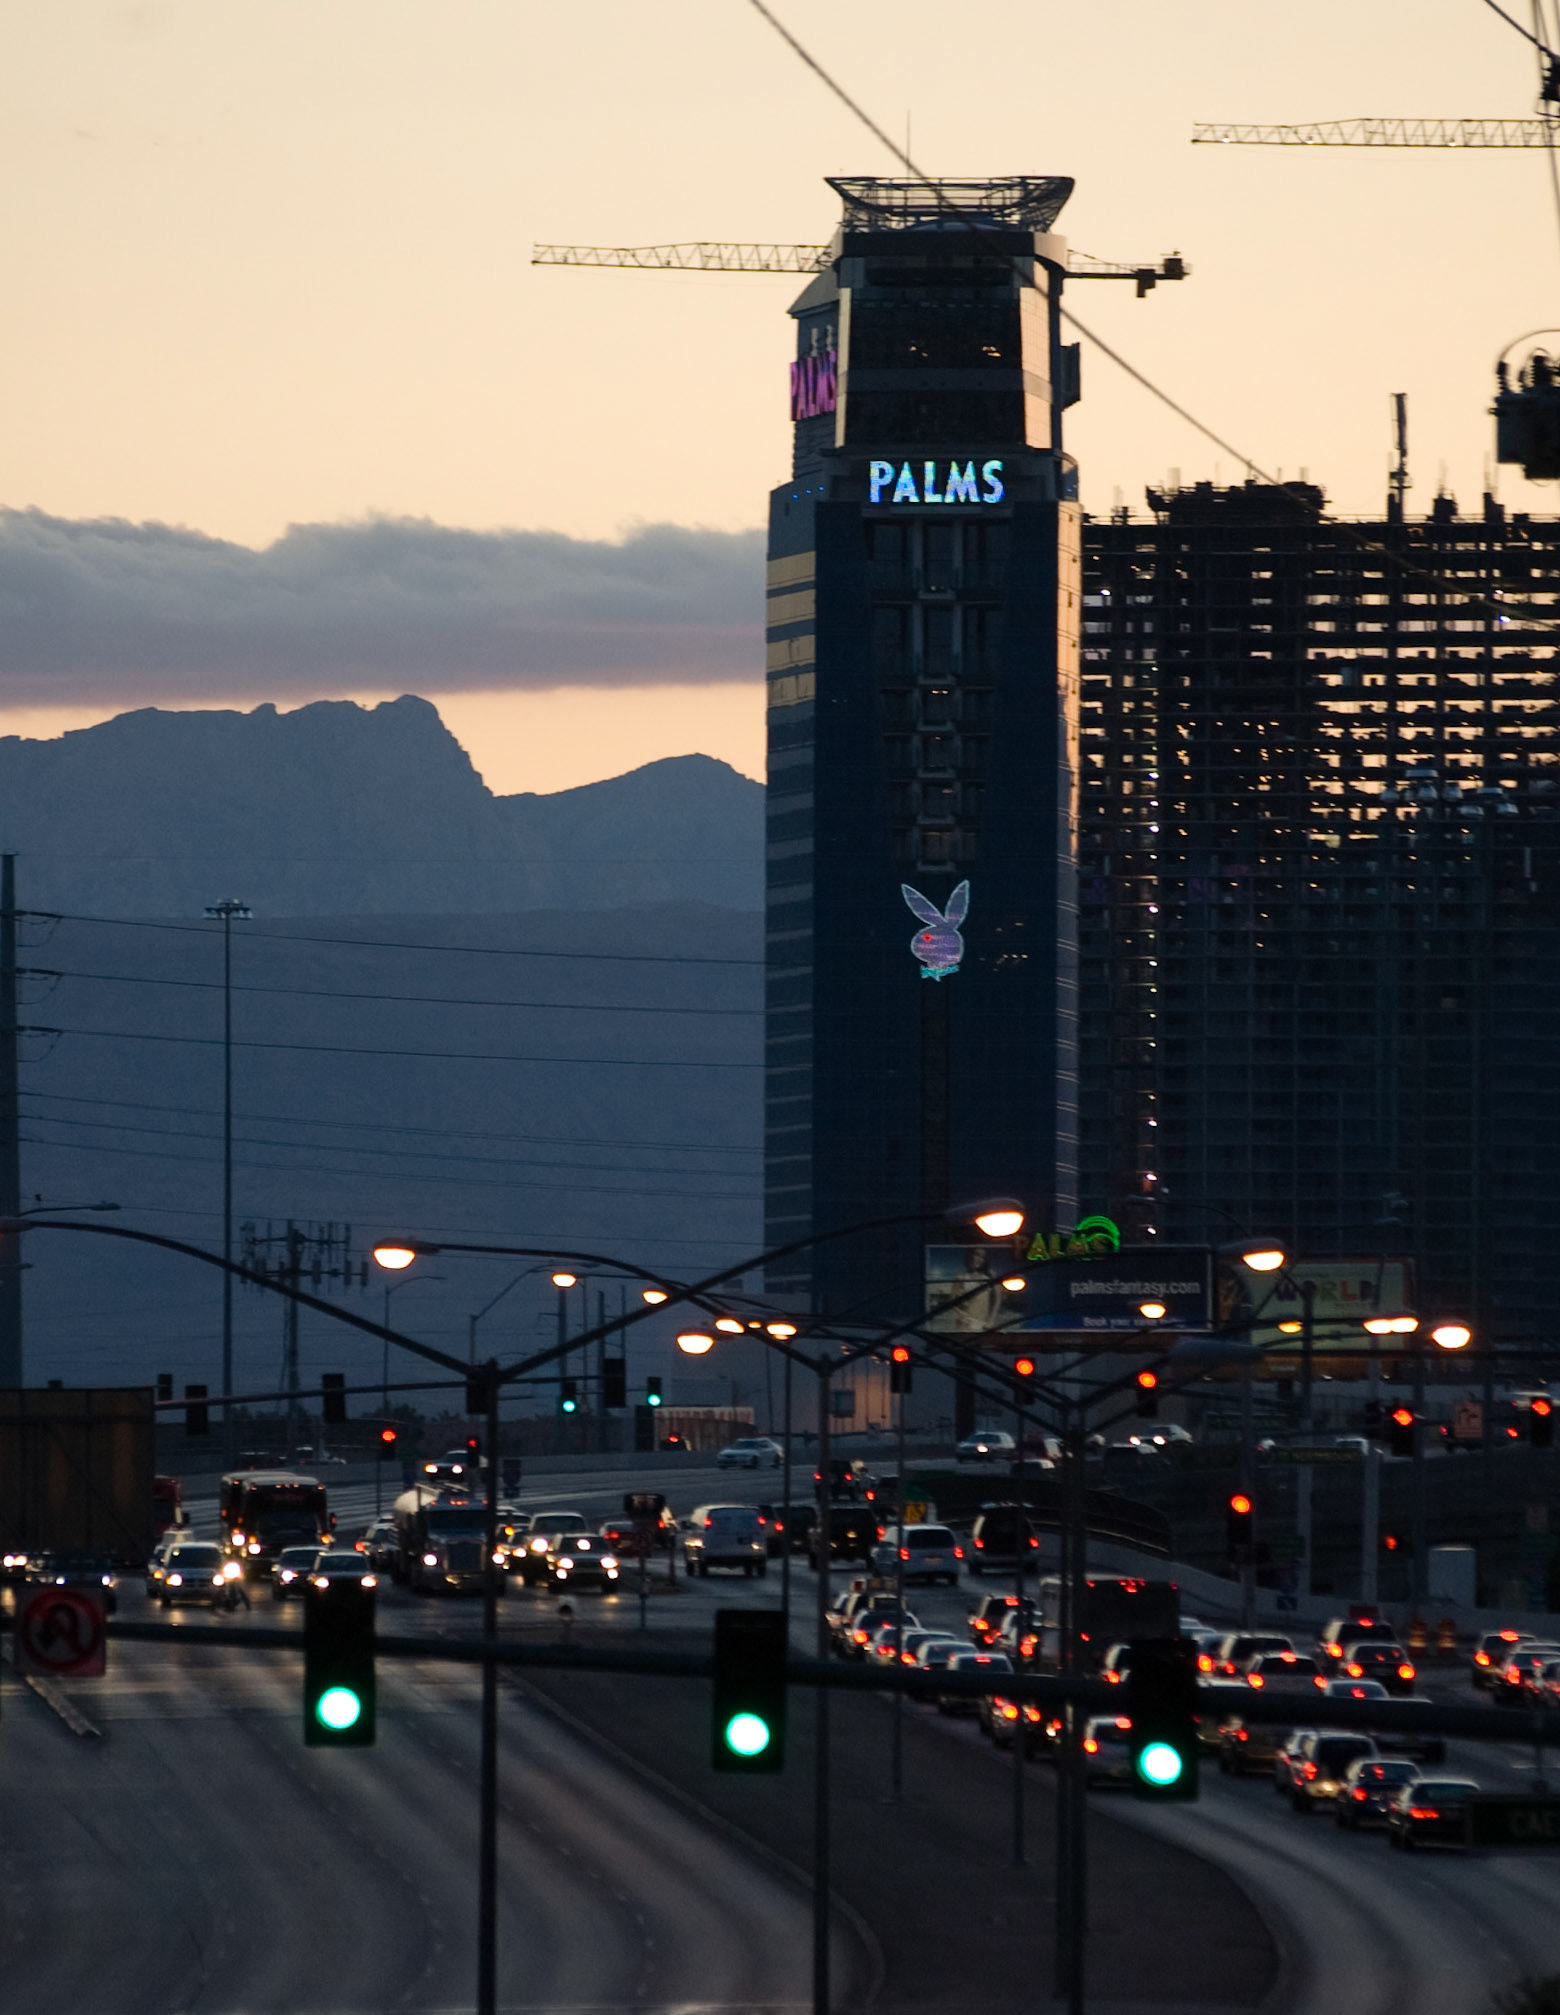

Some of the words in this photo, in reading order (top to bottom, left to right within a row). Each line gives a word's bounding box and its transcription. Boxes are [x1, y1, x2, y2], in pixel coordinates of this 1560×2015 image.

[790, 350, 837, 421] PALMS
[869, 460, 1005, 503] PALMS
[1070, 1281, 1200, 1298] palmsfantasy.com
